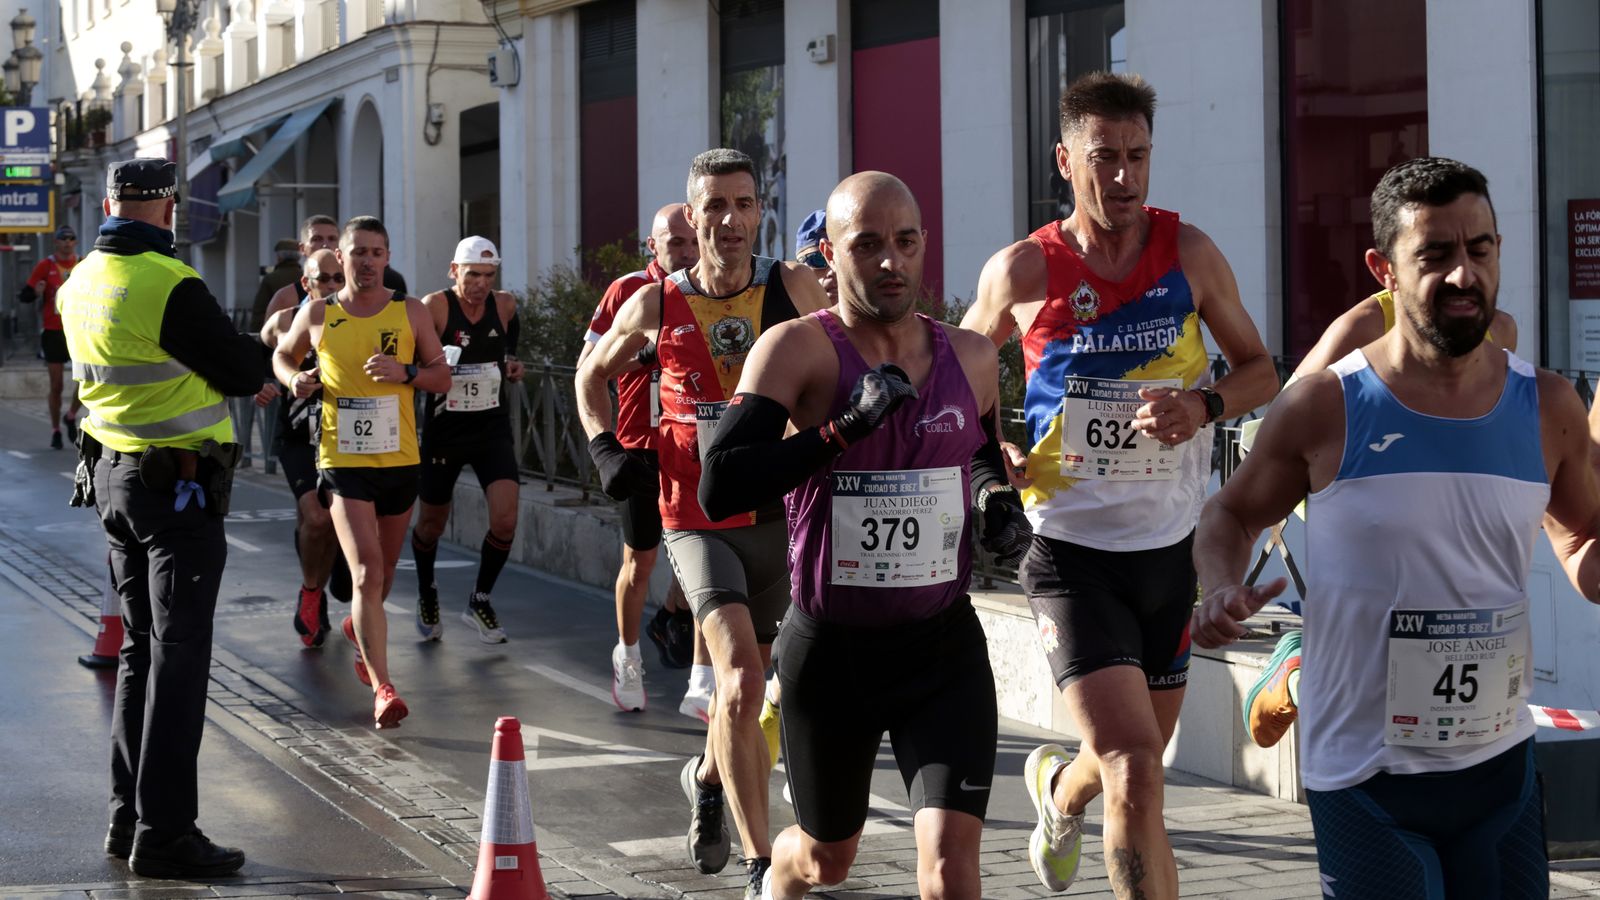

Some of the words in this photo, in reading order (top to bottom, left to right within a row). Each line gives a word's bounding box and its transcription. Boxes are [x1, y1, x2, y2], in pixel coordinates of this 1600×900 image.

[4, 110, 35, 146] P
[1575, 212, 1584, 221] LA
[1586, 209, 1600, 220] FÓR
[1587, 235, 1600, 245] SER
[1575, 248, 1600, 258] EXCLUS
[1070, 326, 1178, 353] PALACIEGO
[463, 382, 479, 397] 15
[1067, 379, 1089, 395] XXV
[697, 405, 714, 417] XXV
[1088, 401, 1113, 412] LUIS
[354, 419, 373, 436] 62
[707, 421, 718, 429] FR
[1086, 418, 1138, 450] 632
[836, 475, 861, 491] XXV
[889, 483, 898, 493] DE
[864, 498, 897, 508] JUAN
[900, 496, 938, 508] DIEGO
[872, 508, 911, 516] MANZORRO
[860, 517, 920, 551] 379
[1395, 614, 1424, 632] XXV
[1456, 623, 1466, 634] DE
[1445, 653, 1479, 662] BELLIDO
[1433, 663, 1479, 704] 45
